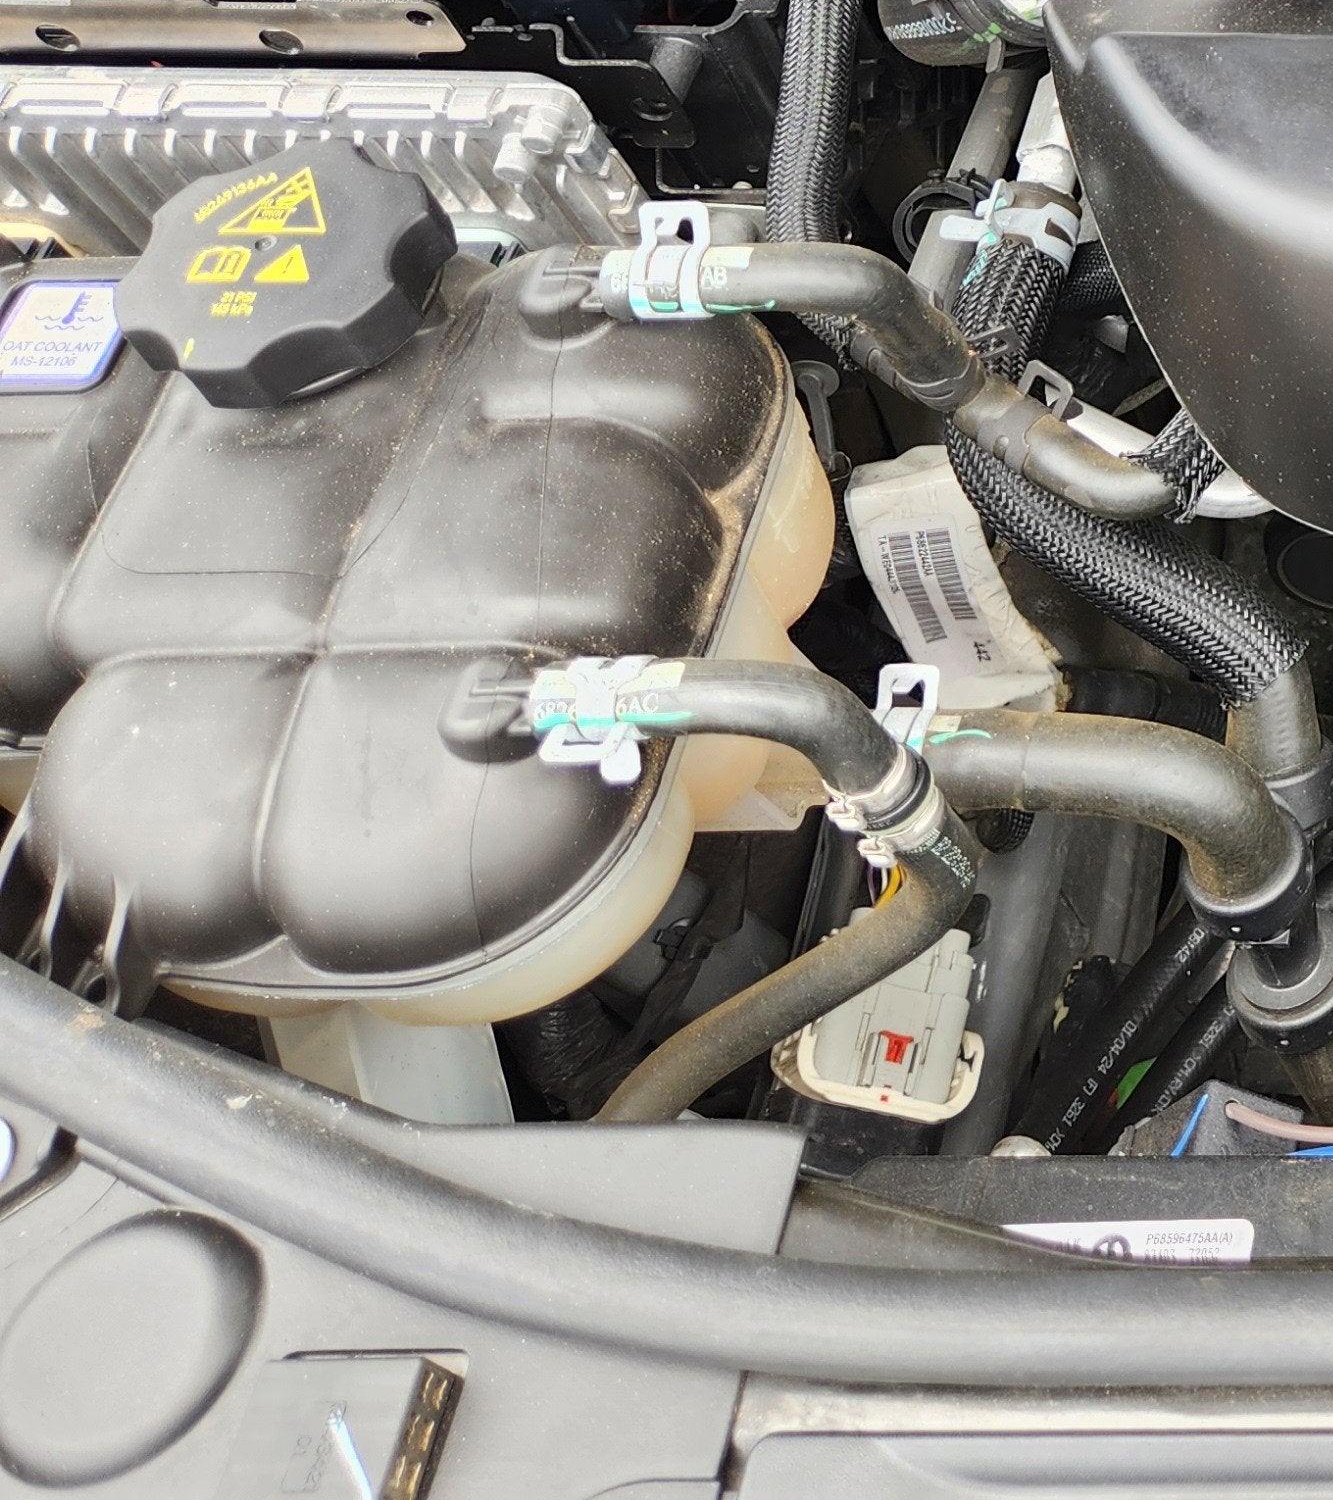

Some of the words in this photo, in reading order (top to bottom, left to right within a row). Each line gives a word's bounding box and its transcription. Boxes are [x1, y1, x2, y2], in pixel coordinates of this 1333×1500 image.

[3, 340, 33, 352] OAT
[33, 340, 103, 352] COOLANT
[10, 356, 77, 367] MS-12106
[1097, 1019, 1138, 1076] 01/04/24
